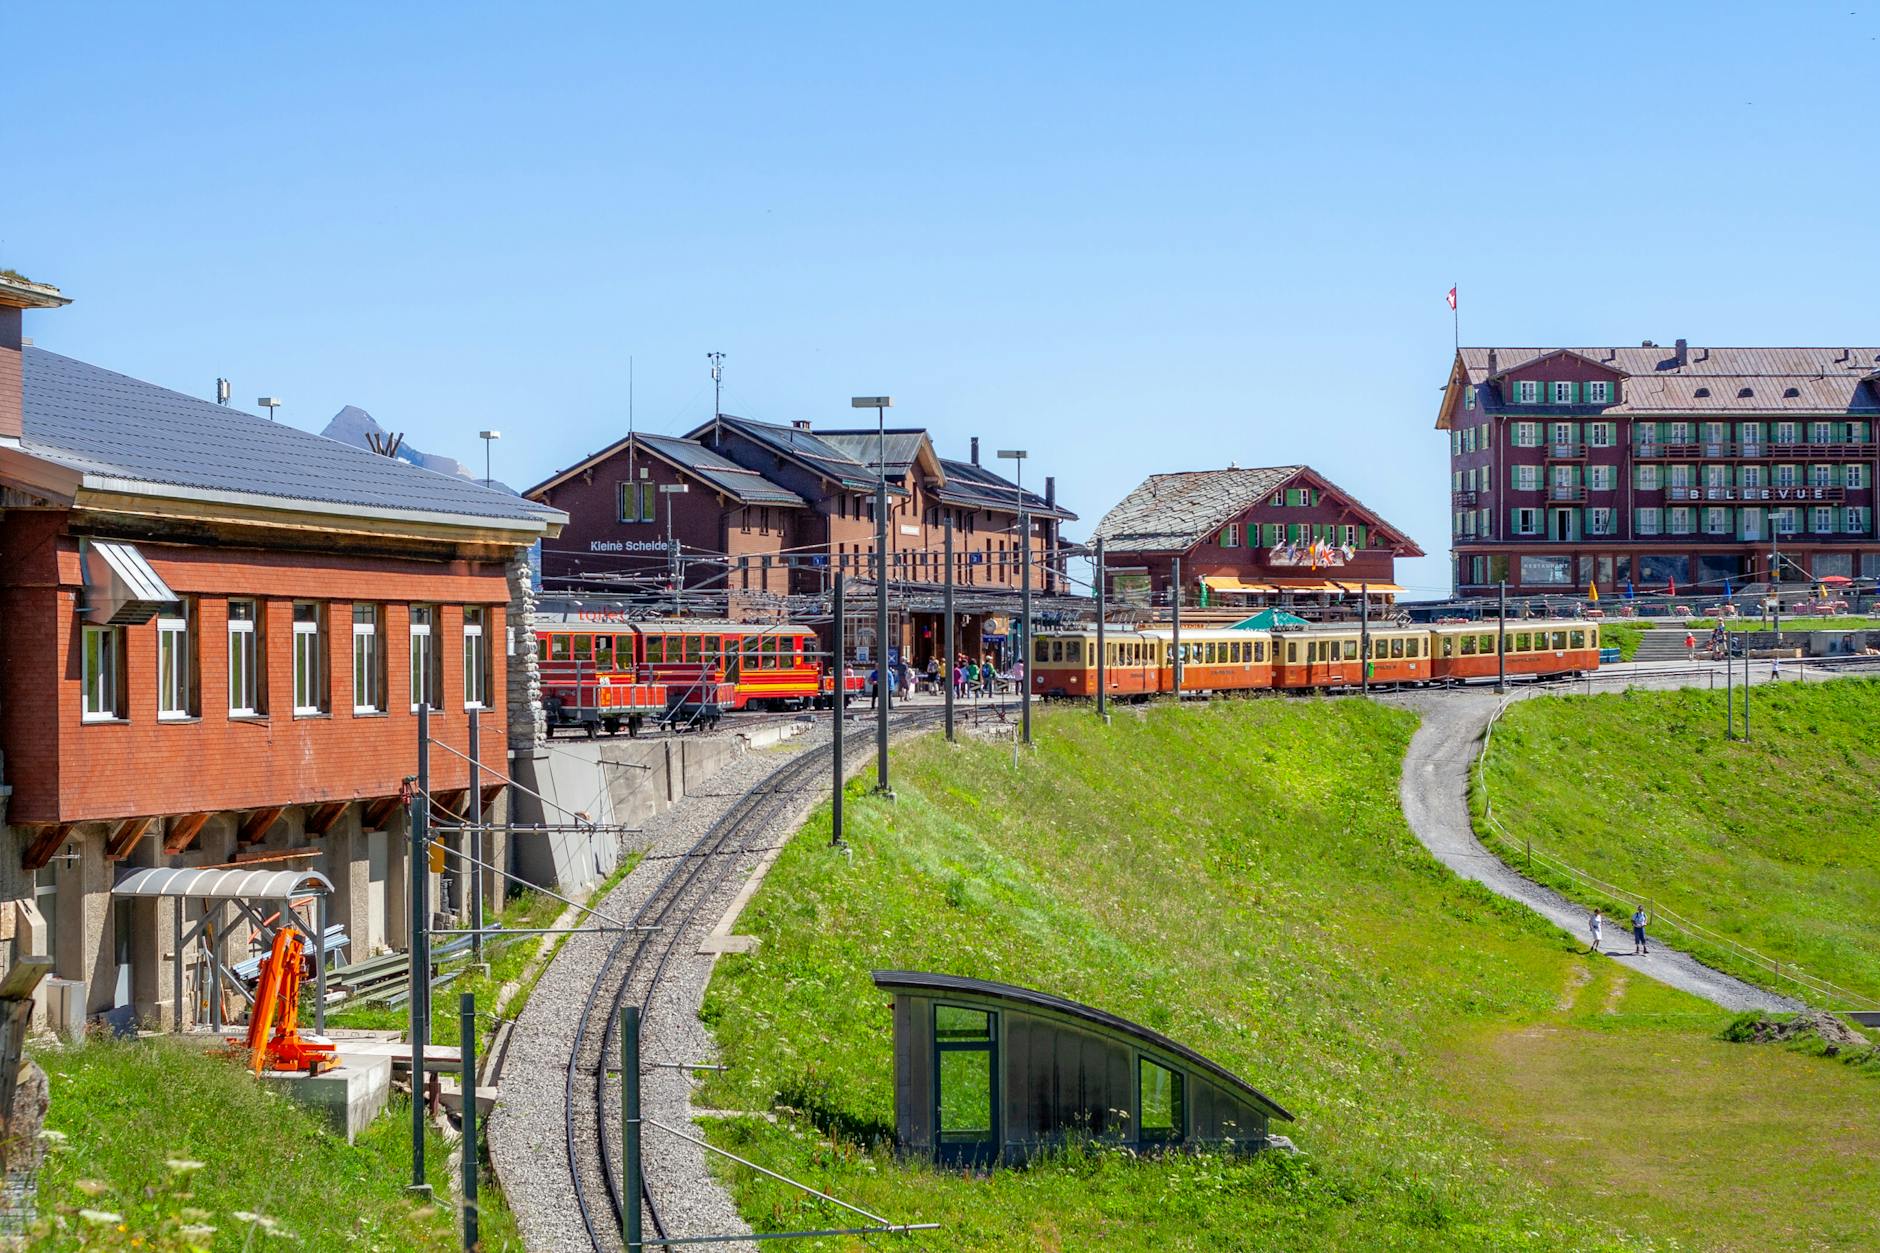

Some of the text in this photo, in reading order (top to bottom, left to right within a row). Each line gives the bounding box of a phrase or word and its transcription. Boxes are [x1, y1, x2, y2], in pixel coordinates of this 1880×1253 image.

[1690, 490, 1823, 499] BELLEVUE
[591, 541, 681, 552] Kleine Scheide
